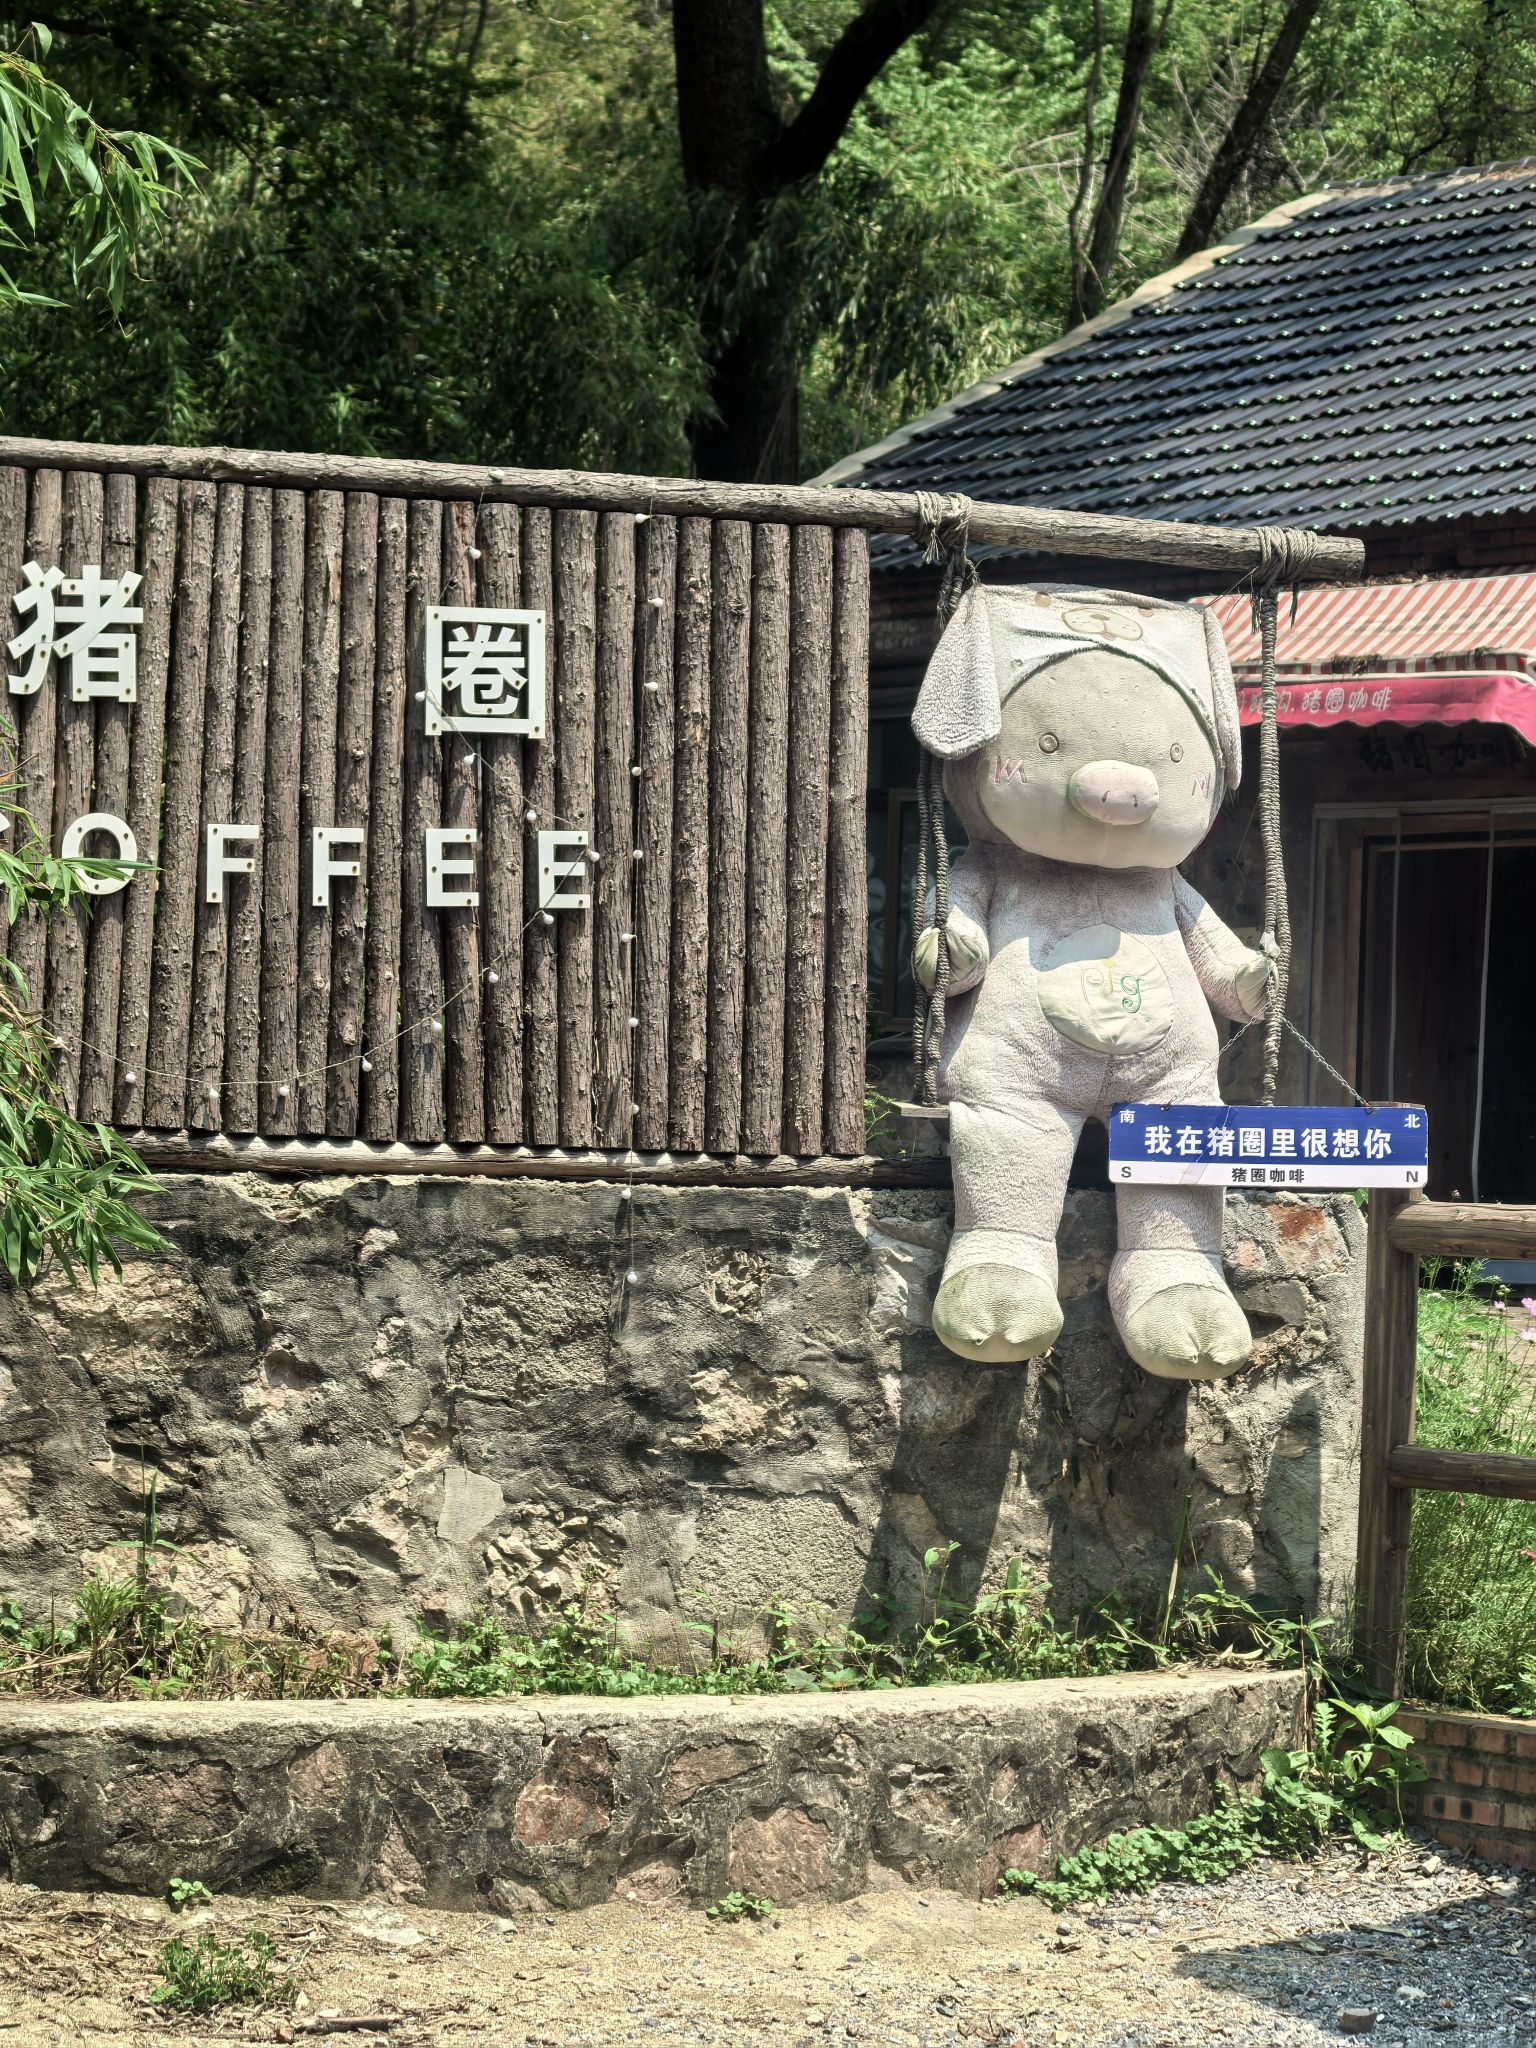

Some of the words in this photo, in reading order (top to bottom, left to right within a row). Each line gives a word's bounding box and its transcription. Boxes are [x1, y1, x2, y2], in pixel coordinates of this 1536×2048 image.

[0, 811, 590, 909] OFFEE
[1119, 1109, 1136, 1125] 南
[1404, 1113, 1421, 1129] 北
[1144, 1124, 1393, 1160] 我在猪圈里很想你
[1120, 1166, 1132, 1179] S
[1231, 1167, 1305, 1183] 猪圈咖啡
[1406, 1170, 1419, 1184] N
